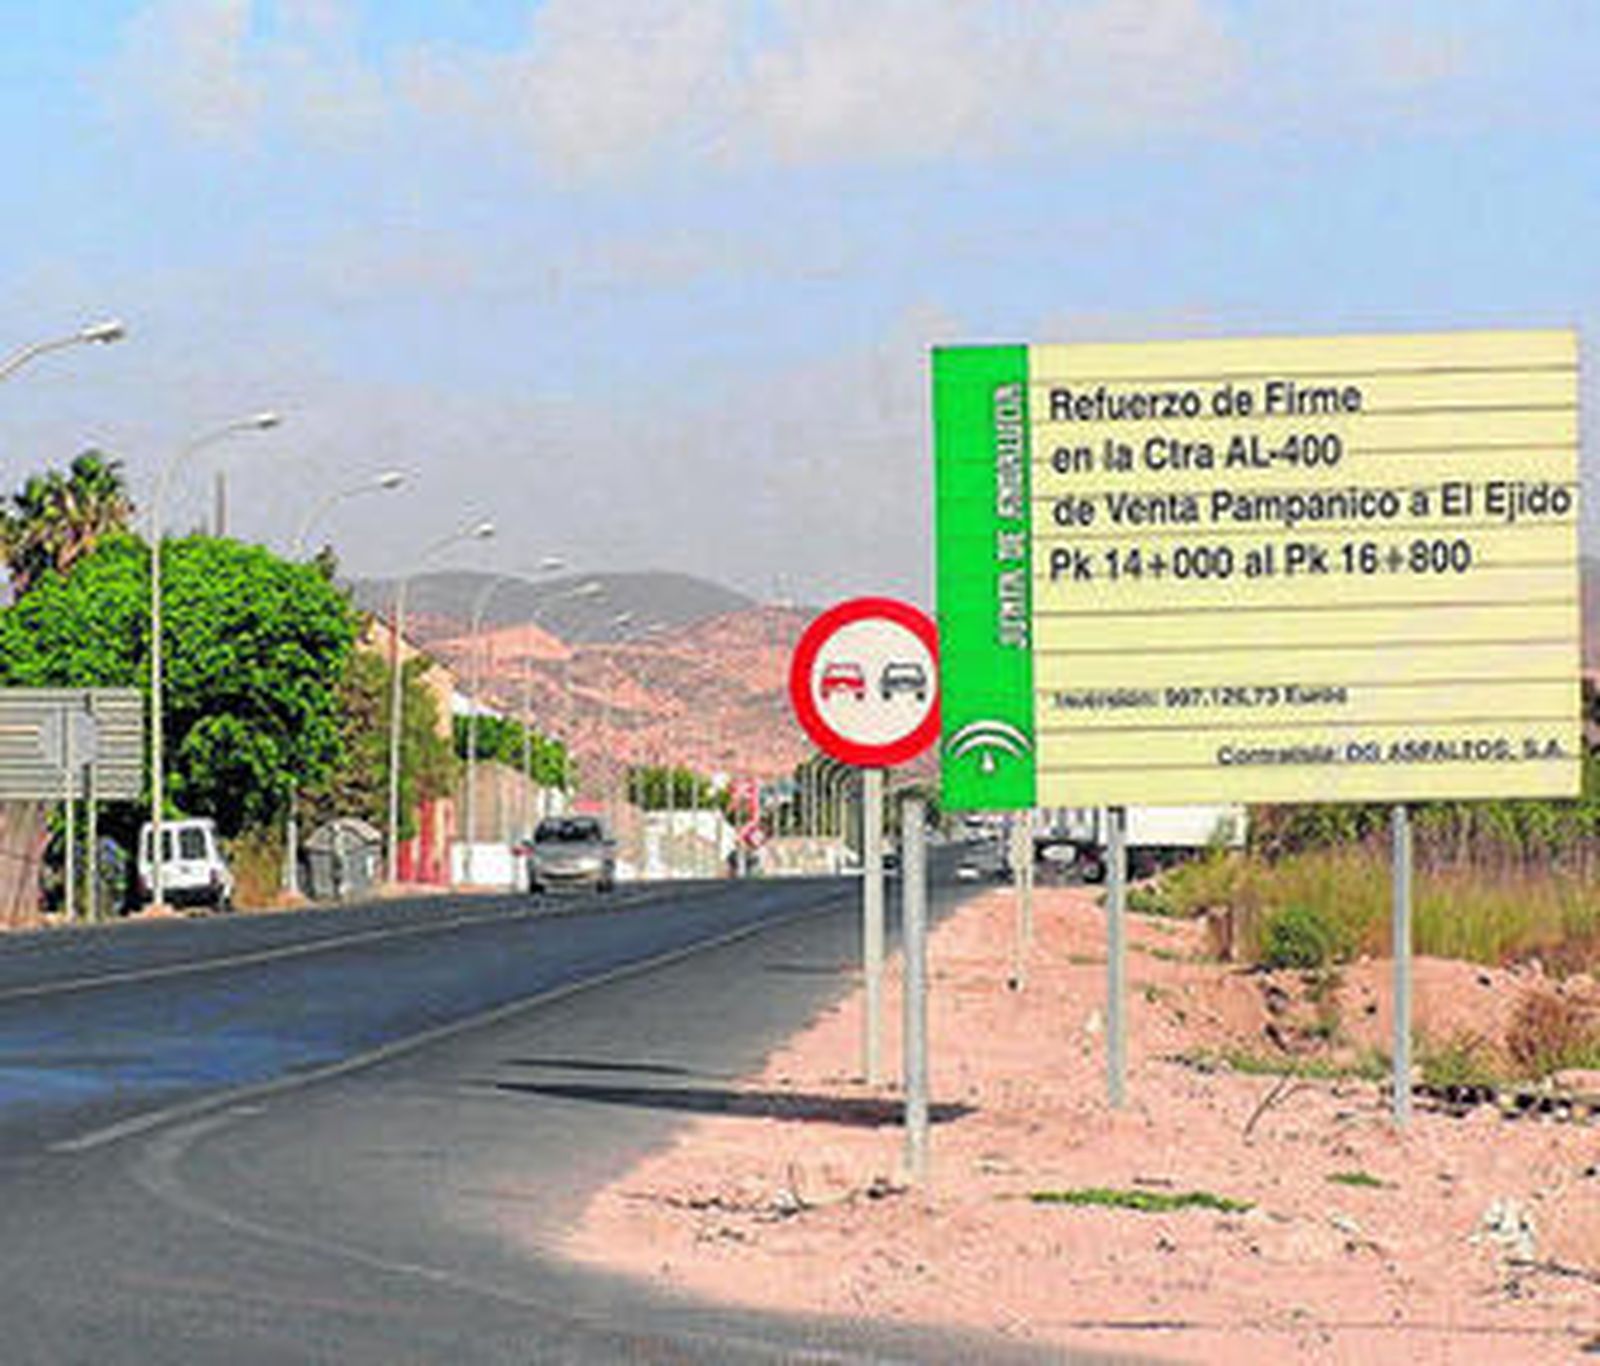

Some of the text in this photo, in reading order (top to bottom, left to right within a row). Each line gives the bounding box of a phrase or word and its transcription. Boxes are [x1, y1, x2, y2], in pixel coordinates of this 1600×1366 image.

[1050, 381, 1362, 421] Refuerzo de Firme
[1052, 433, 1343, 473] en la Ctra AL-400
[1053, 481, 1572, 529] de Venta Pampanico a El Ejido
[1050, 539, 1472, 580] Pk 14+000 al Pk 16+800
